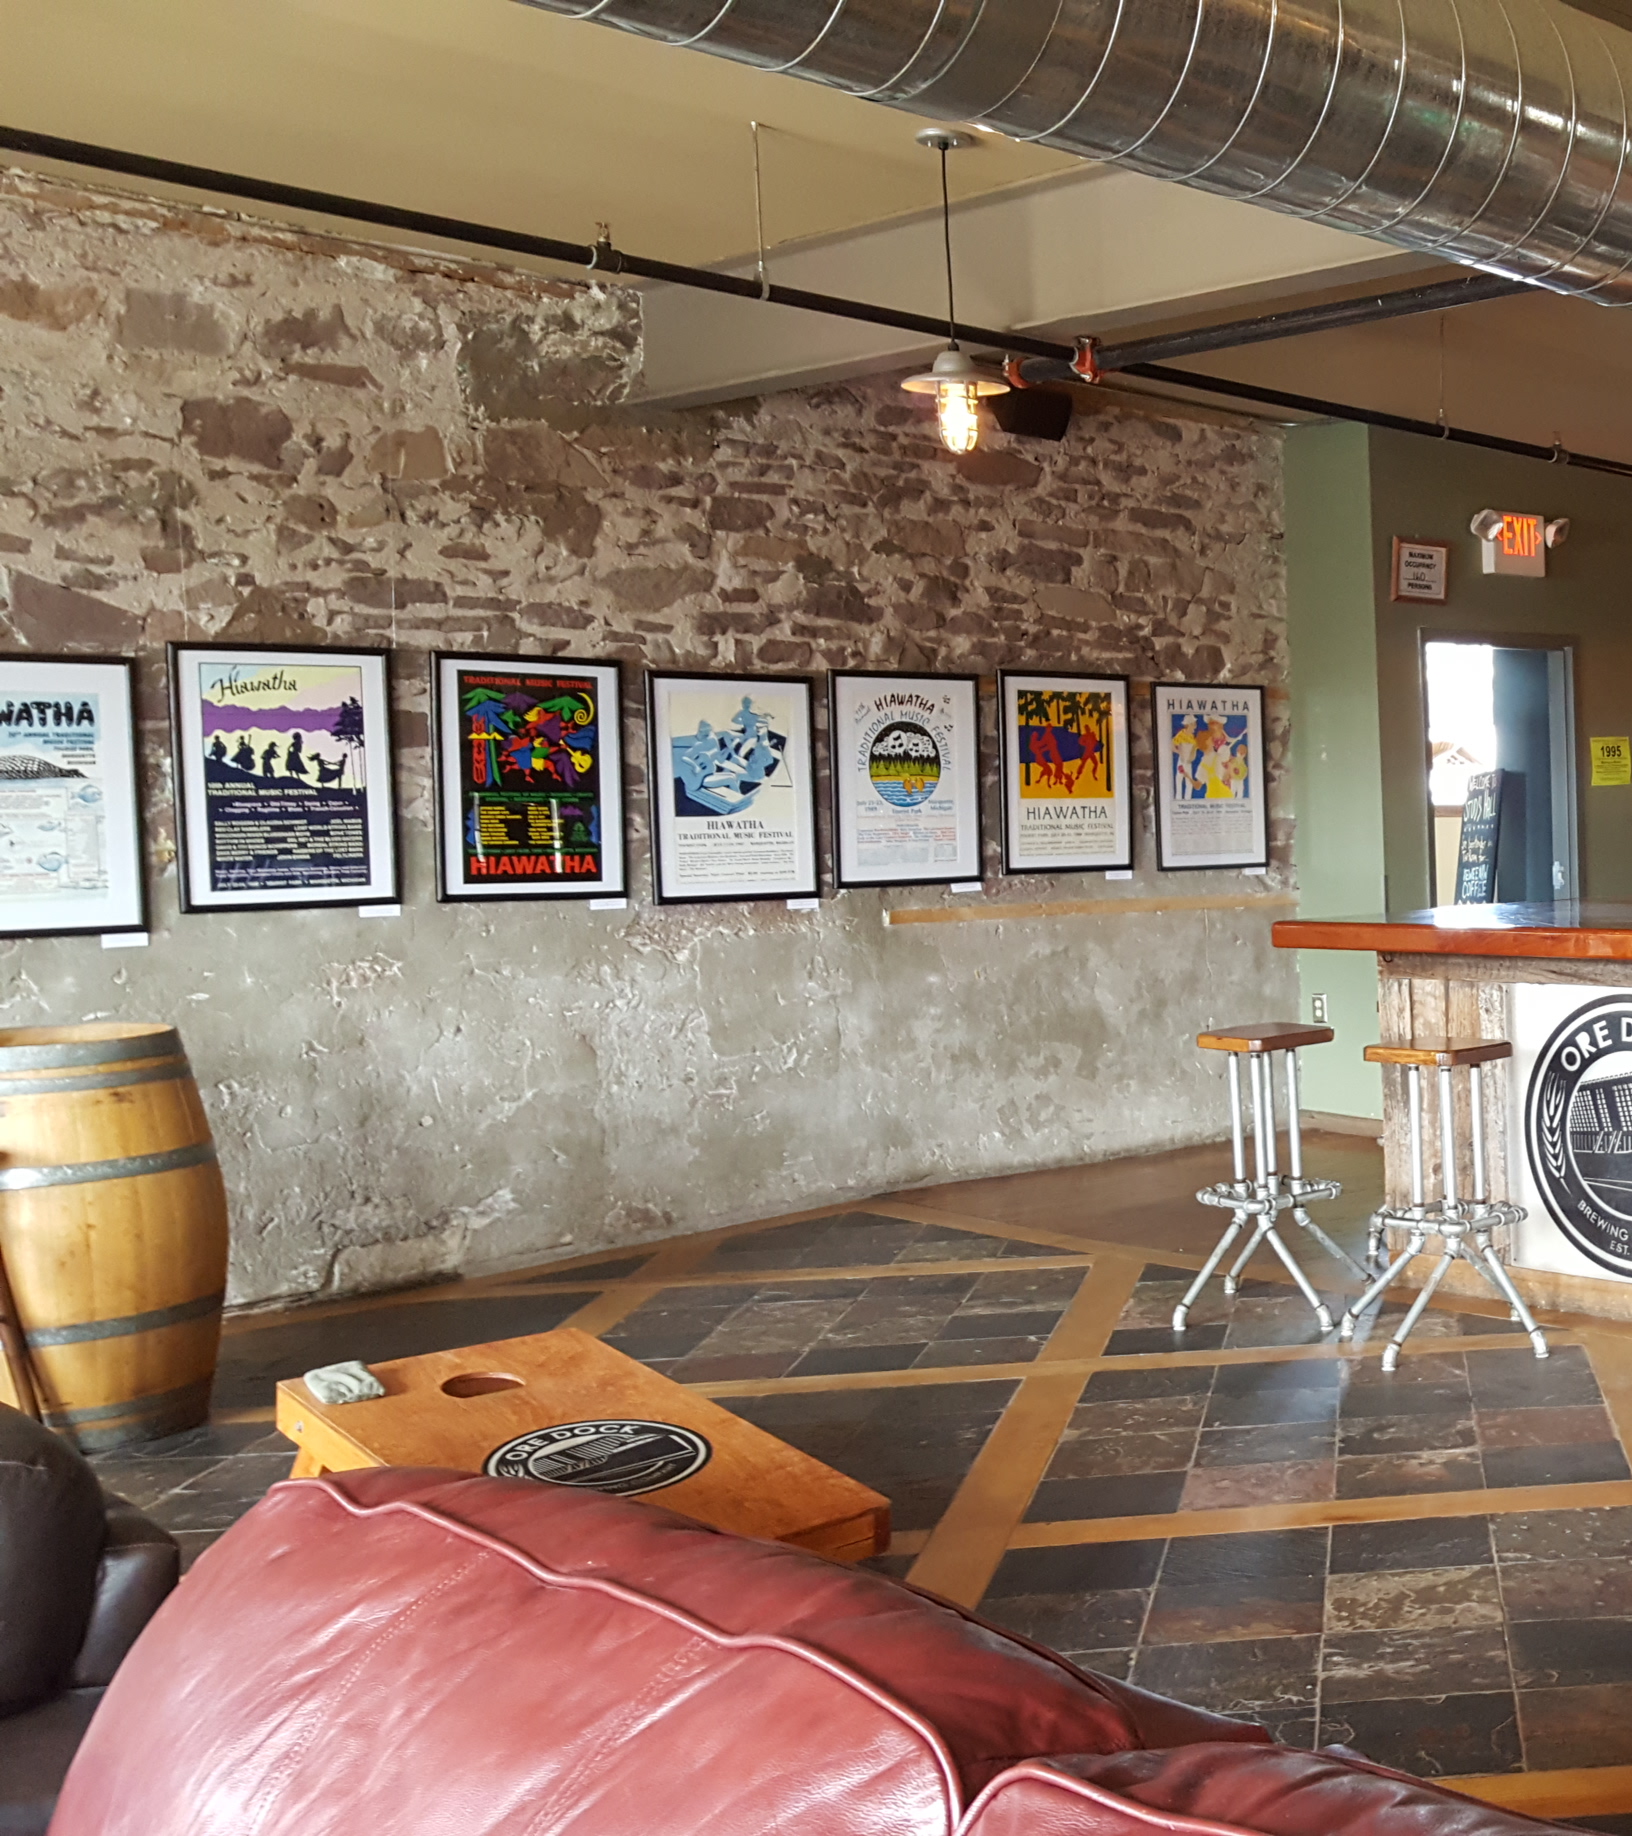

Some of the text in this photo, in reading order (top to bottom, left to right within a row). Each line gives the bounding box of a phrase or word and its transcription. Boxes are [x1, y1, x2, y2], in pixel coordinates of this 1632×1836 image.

[1502, 515, 1537, 557] EXIT
[210, 664, 298, 704] Hiawatha
[463, 675, 593, 689] TRADITIONAL MUSIC FESTIVAL
[874, 693, 935, 715] HIAWATHA
[1167, 699, 1250, 712] HIAWATHA
[857, 711, 896, 773] TRADITIONAL
[900, 709, 931, 727] MUSIC
[932, 725, 952, 771] FESTIVAL
[1600, 745, 1622, 757] 1995
[1026, 806, 1108, 820] HIAWATHA
[706, 820, 764, 831] HIAWATHA
[1020, 822, 1114, 831] TRADITIONAL MUSIC FESTIVAL
[678, 832, 731, 840] TRADITIONAL
[758, 831, 794, 839] FESTIVAL
[470, 854, 598, 876] HIAWATHA
[1560, 1020, 1613, 1072] ORE
[1577, 1199, 1630, 1243] BREWING
[1609, 1240, 1631, 1255] EST.
[504, 1424, 642, 1461] ORE DOCK
